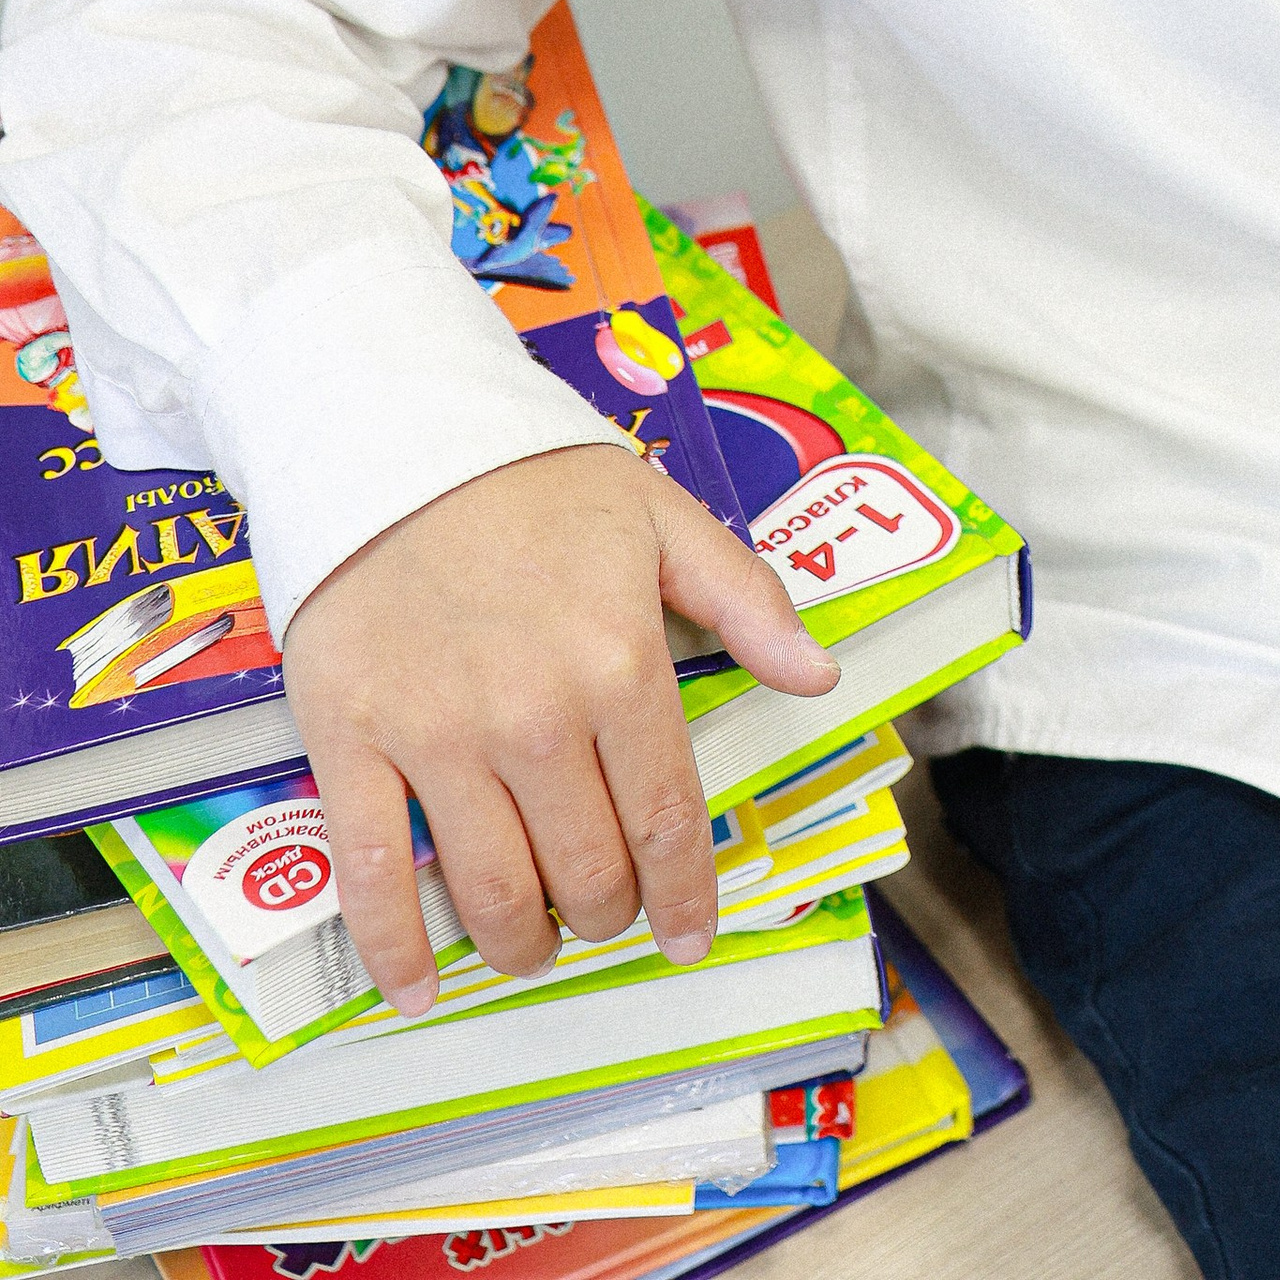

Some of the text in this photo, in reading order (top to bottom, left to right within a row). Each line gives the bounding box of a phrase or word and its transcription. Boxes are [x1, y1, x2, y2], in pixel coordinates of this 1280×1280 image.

[15, 502, 247, 604] АТИЯ
[214, 824, 329, 880] ерактивным
[258, 860, 322, 906] CD
